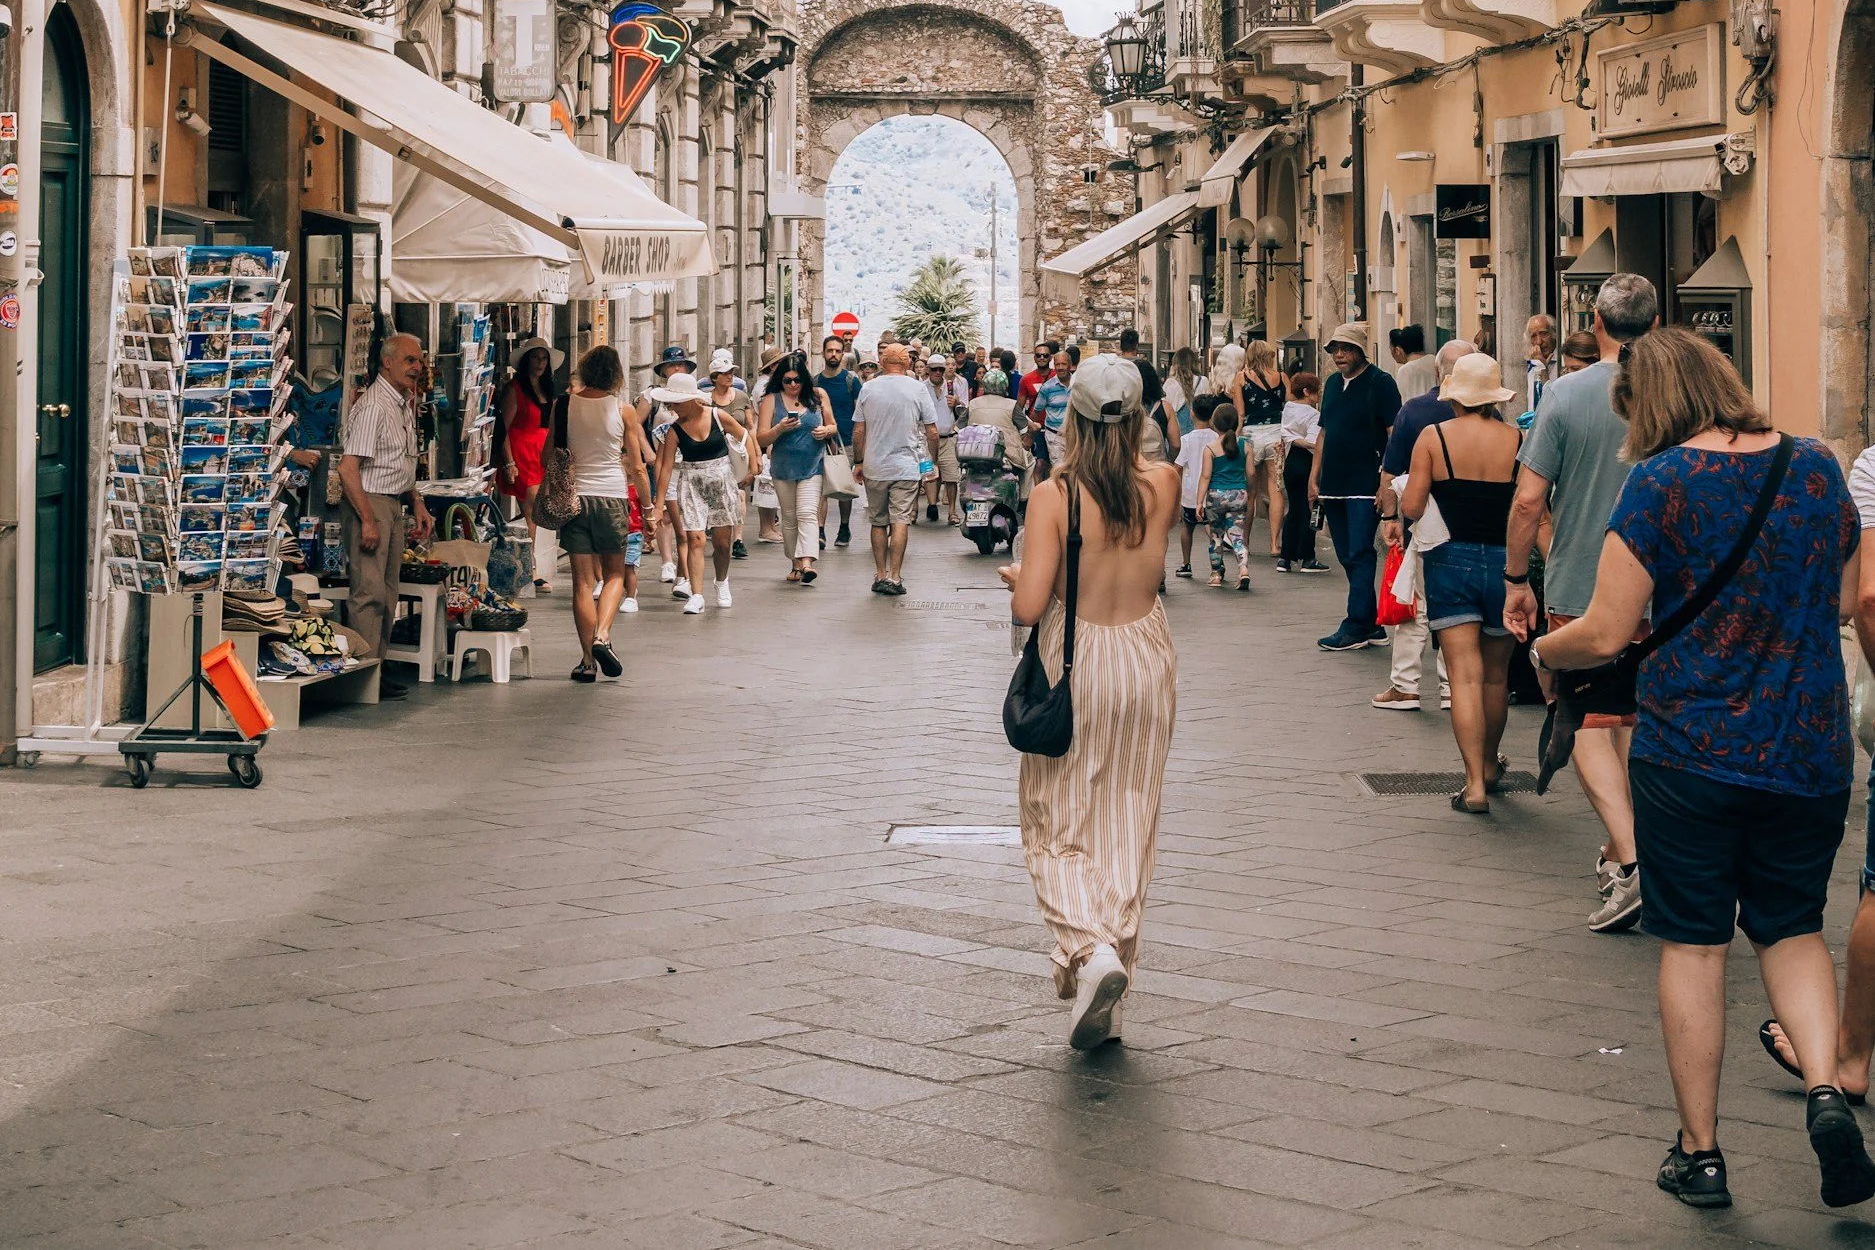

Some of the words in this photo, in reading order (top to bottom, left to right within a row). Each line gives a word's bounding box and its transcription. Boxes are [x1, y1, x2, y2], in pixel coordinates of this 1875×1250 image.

[499, 66, 550, 76] TABACCHI
[498, 88, 522, 97] VALORI
[523, 88, 550, 98] BOLLATI
[1613, 61, 1650, 116] Gioielli
[1438, 200, 1488, 222] Borsalino
[601, 235, 642, 277] BARBER
[646, 236, 671, 274] SHOP
